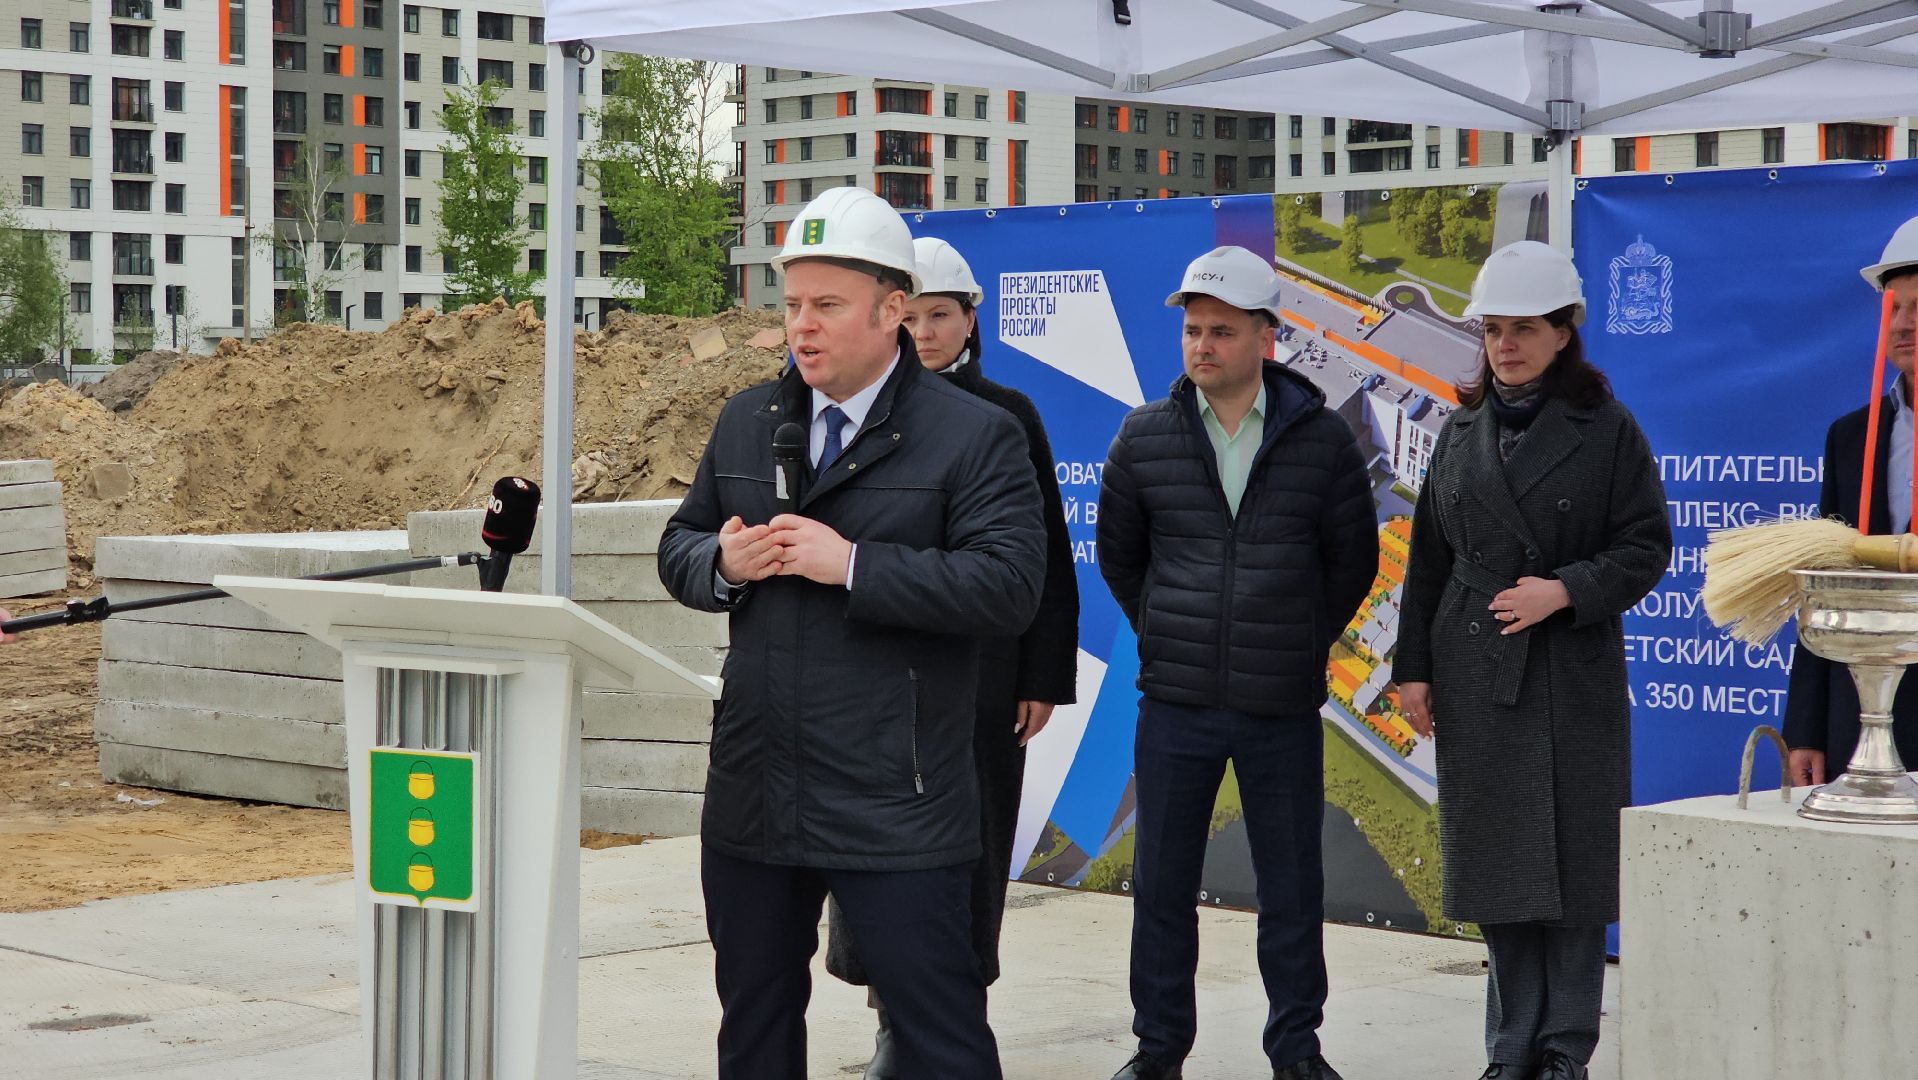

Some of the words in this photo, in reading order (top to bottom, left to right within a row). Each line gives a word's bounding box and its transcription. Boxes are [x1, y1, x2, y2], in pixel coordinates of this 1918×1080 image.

[1001, 273, 1100, 295] ПРЕЗИДЕНТСКИЕ
[1001, 296, 1056, 316] ПРОЕКТЫ
[1001, 317, 1046, 337] РОССИИ
[1653, 455, 1825, 483] ПИТАТЕЛЬ
[1070, 540, 1097, 564] АТ
[1645, 681, 1694, 711] 350
[1702, 685, 1788, 717] МЕСТ
